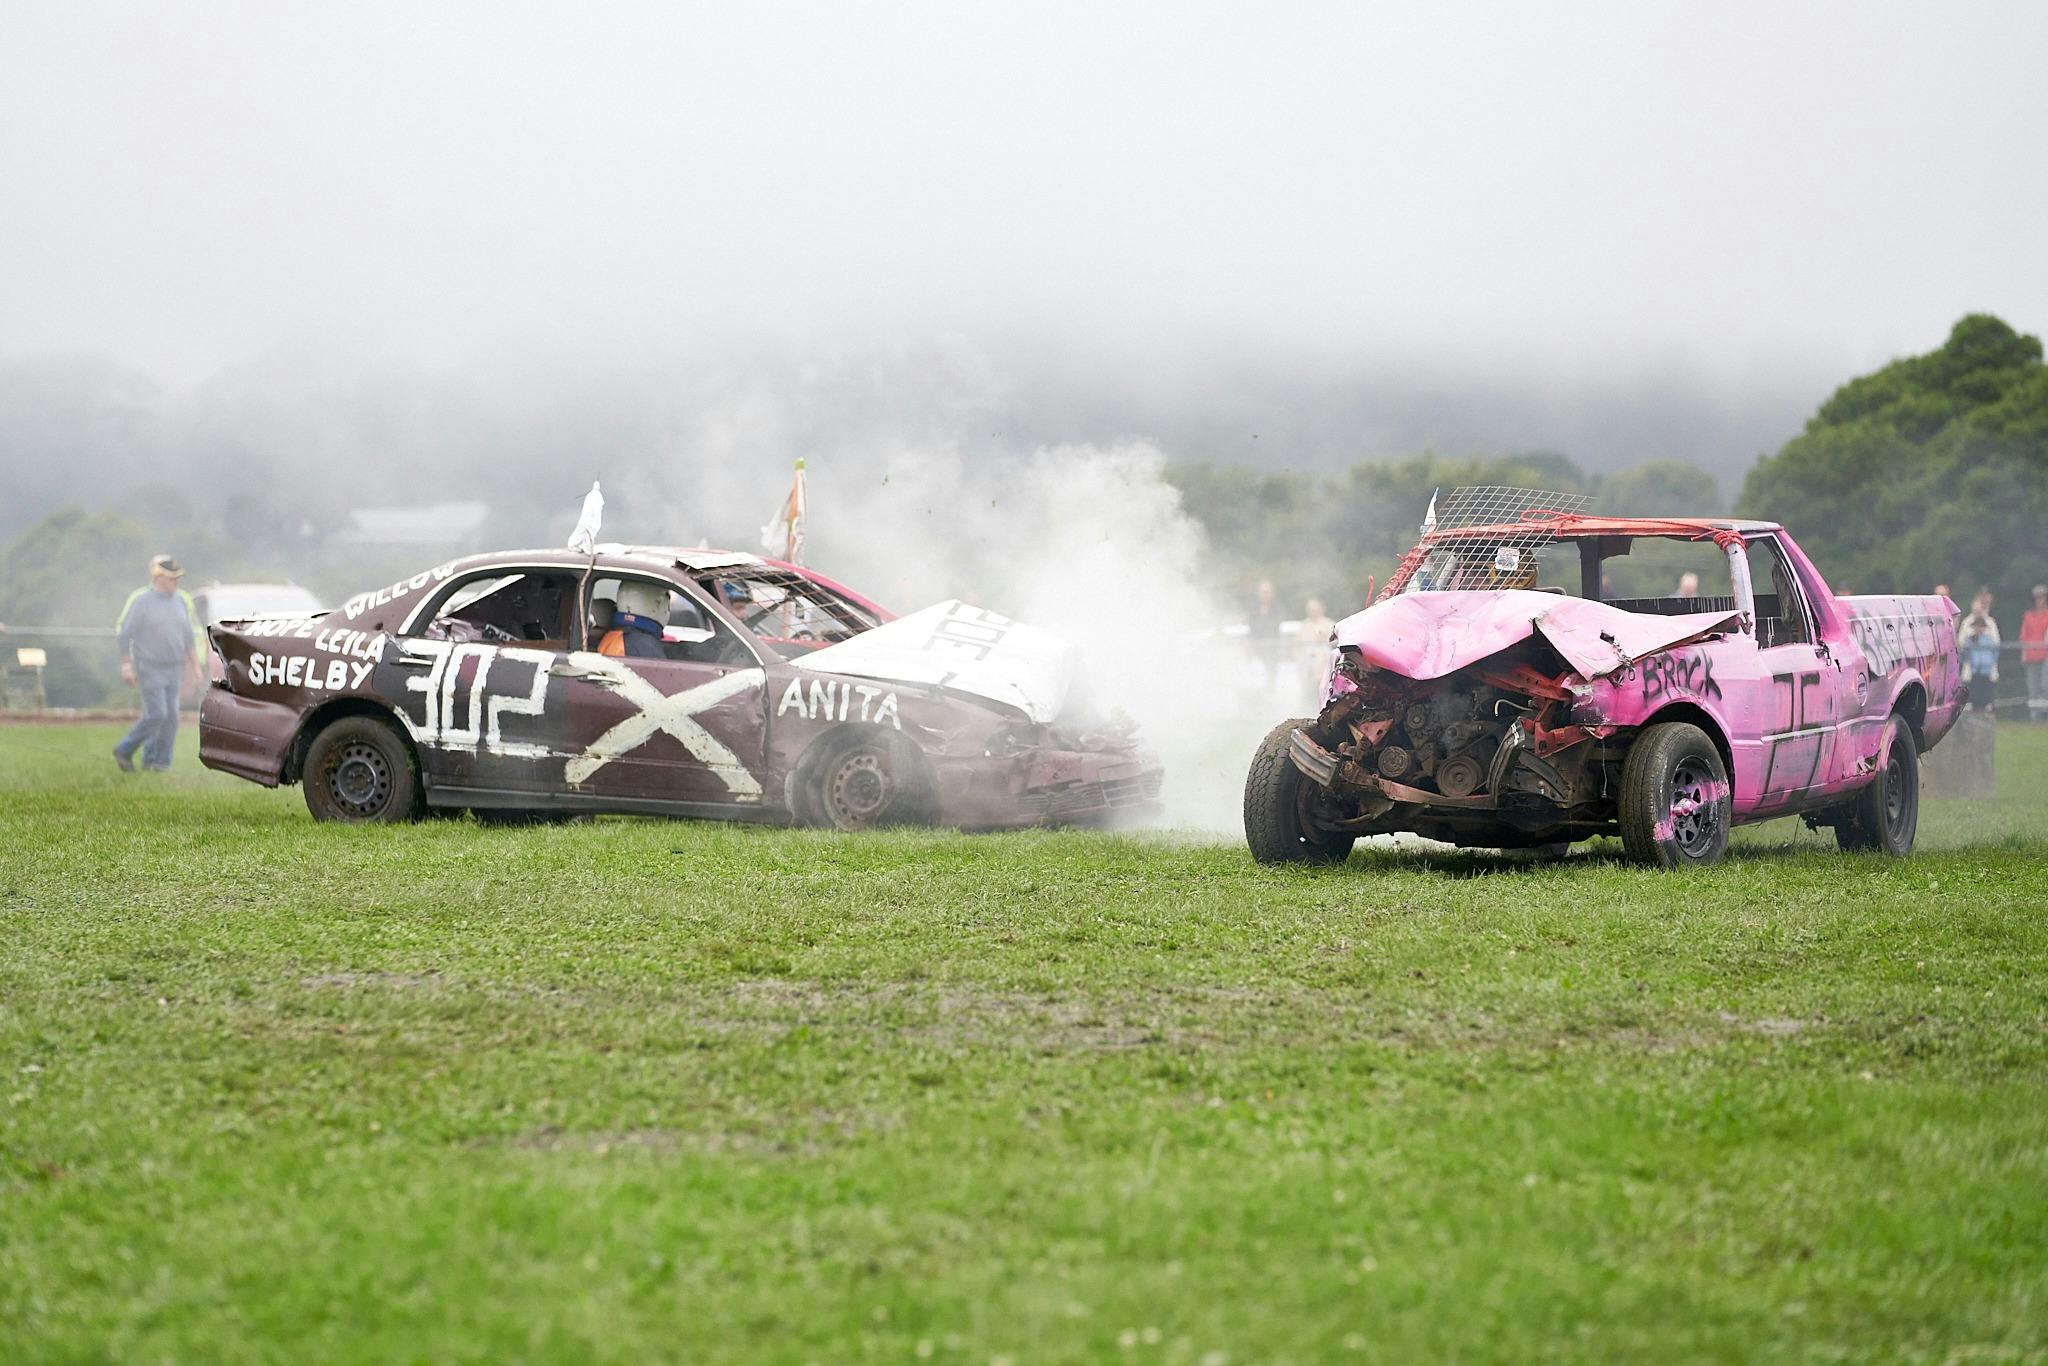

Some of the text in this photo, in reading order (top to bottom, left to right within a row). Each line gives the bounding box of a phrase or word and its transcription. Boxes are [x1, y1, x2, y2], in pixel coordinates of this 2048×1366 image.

[343, 564, 456, 620] WILLOW
[248, 652, 373, 690] SHELBY
[315, 628, 387, 664] LEILA
[778, 677, 901, 730] ANITA
[1642, 648, 1723, 708] BROCK
